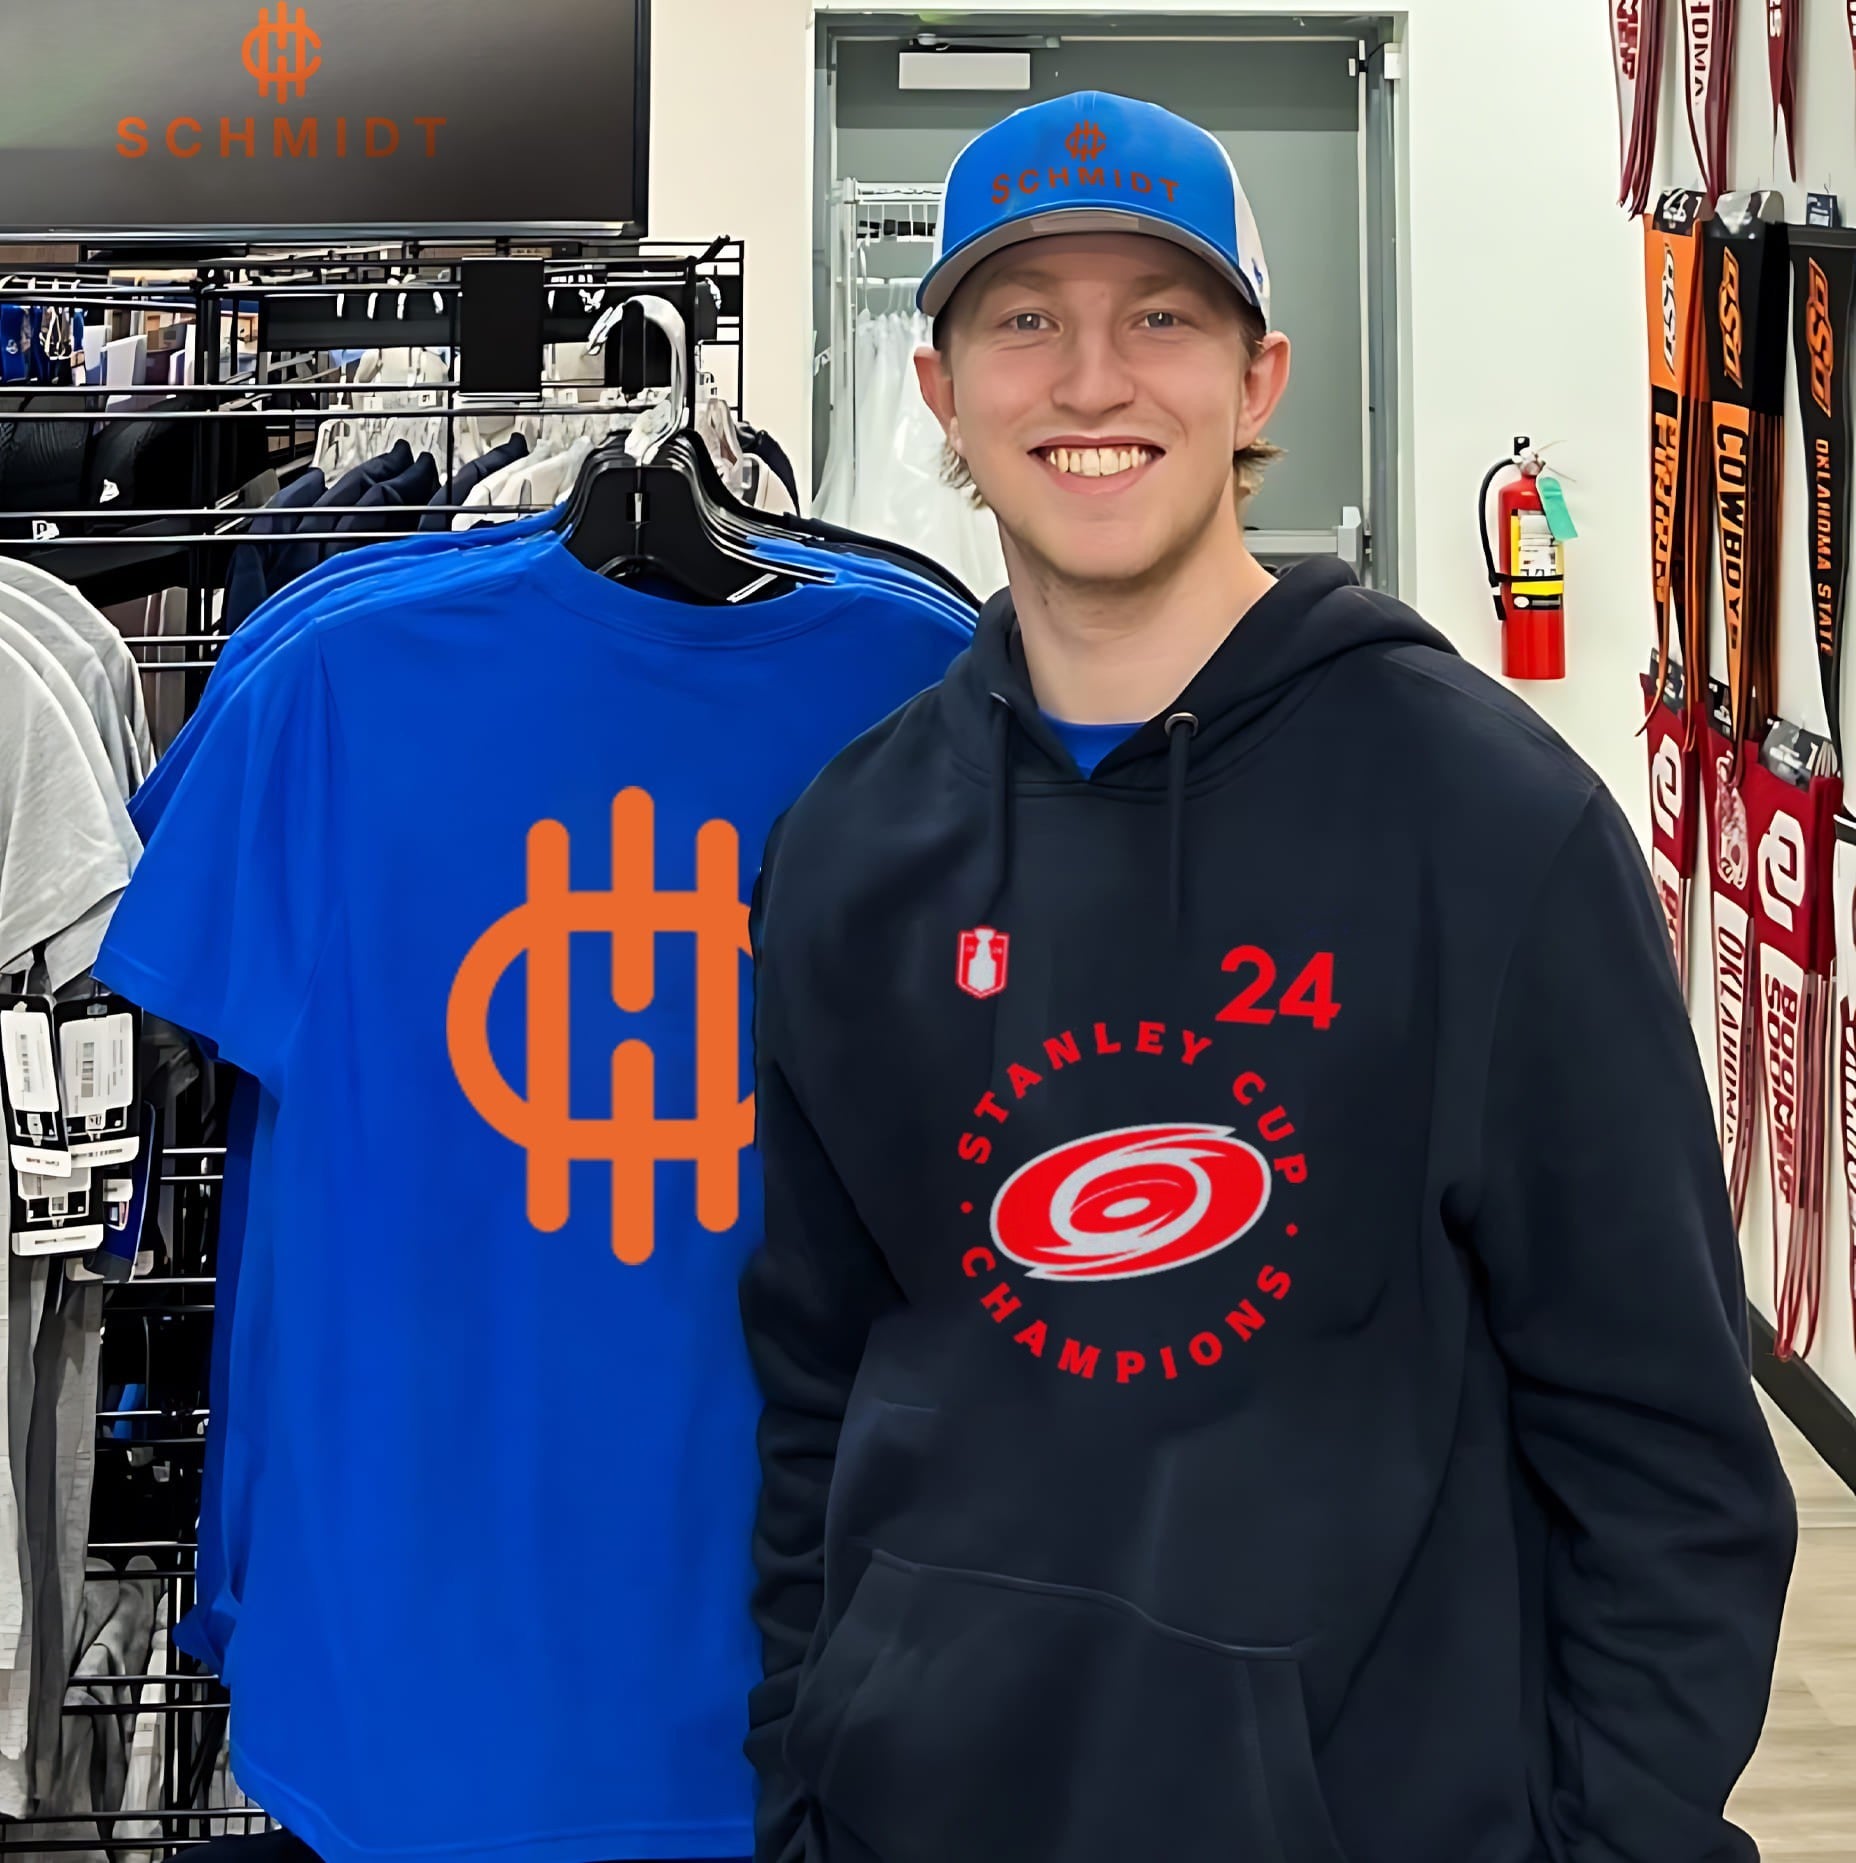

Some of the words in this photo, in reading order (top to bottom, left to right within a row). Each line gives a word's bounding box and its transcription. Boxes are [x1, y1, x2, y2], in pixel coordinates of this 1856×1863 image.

[116, 116, 448, 159] SCHMIDT
[992, 166, 1180, 204] SCHMIDT
[1815, 438, 1832, 570] OKLAHOMA
[1817, 583, 1834, 657] STATE
[1215, 945, 1342, 1030] 24
[1718, 926, 1745, 1144] OKLAHOMA
[957, 1021, 1212, 1165] STANLEY
[1232, 1072, 1308, 1183] CUP
[961, 1246, 1292, 1384] CHAMPIONS
